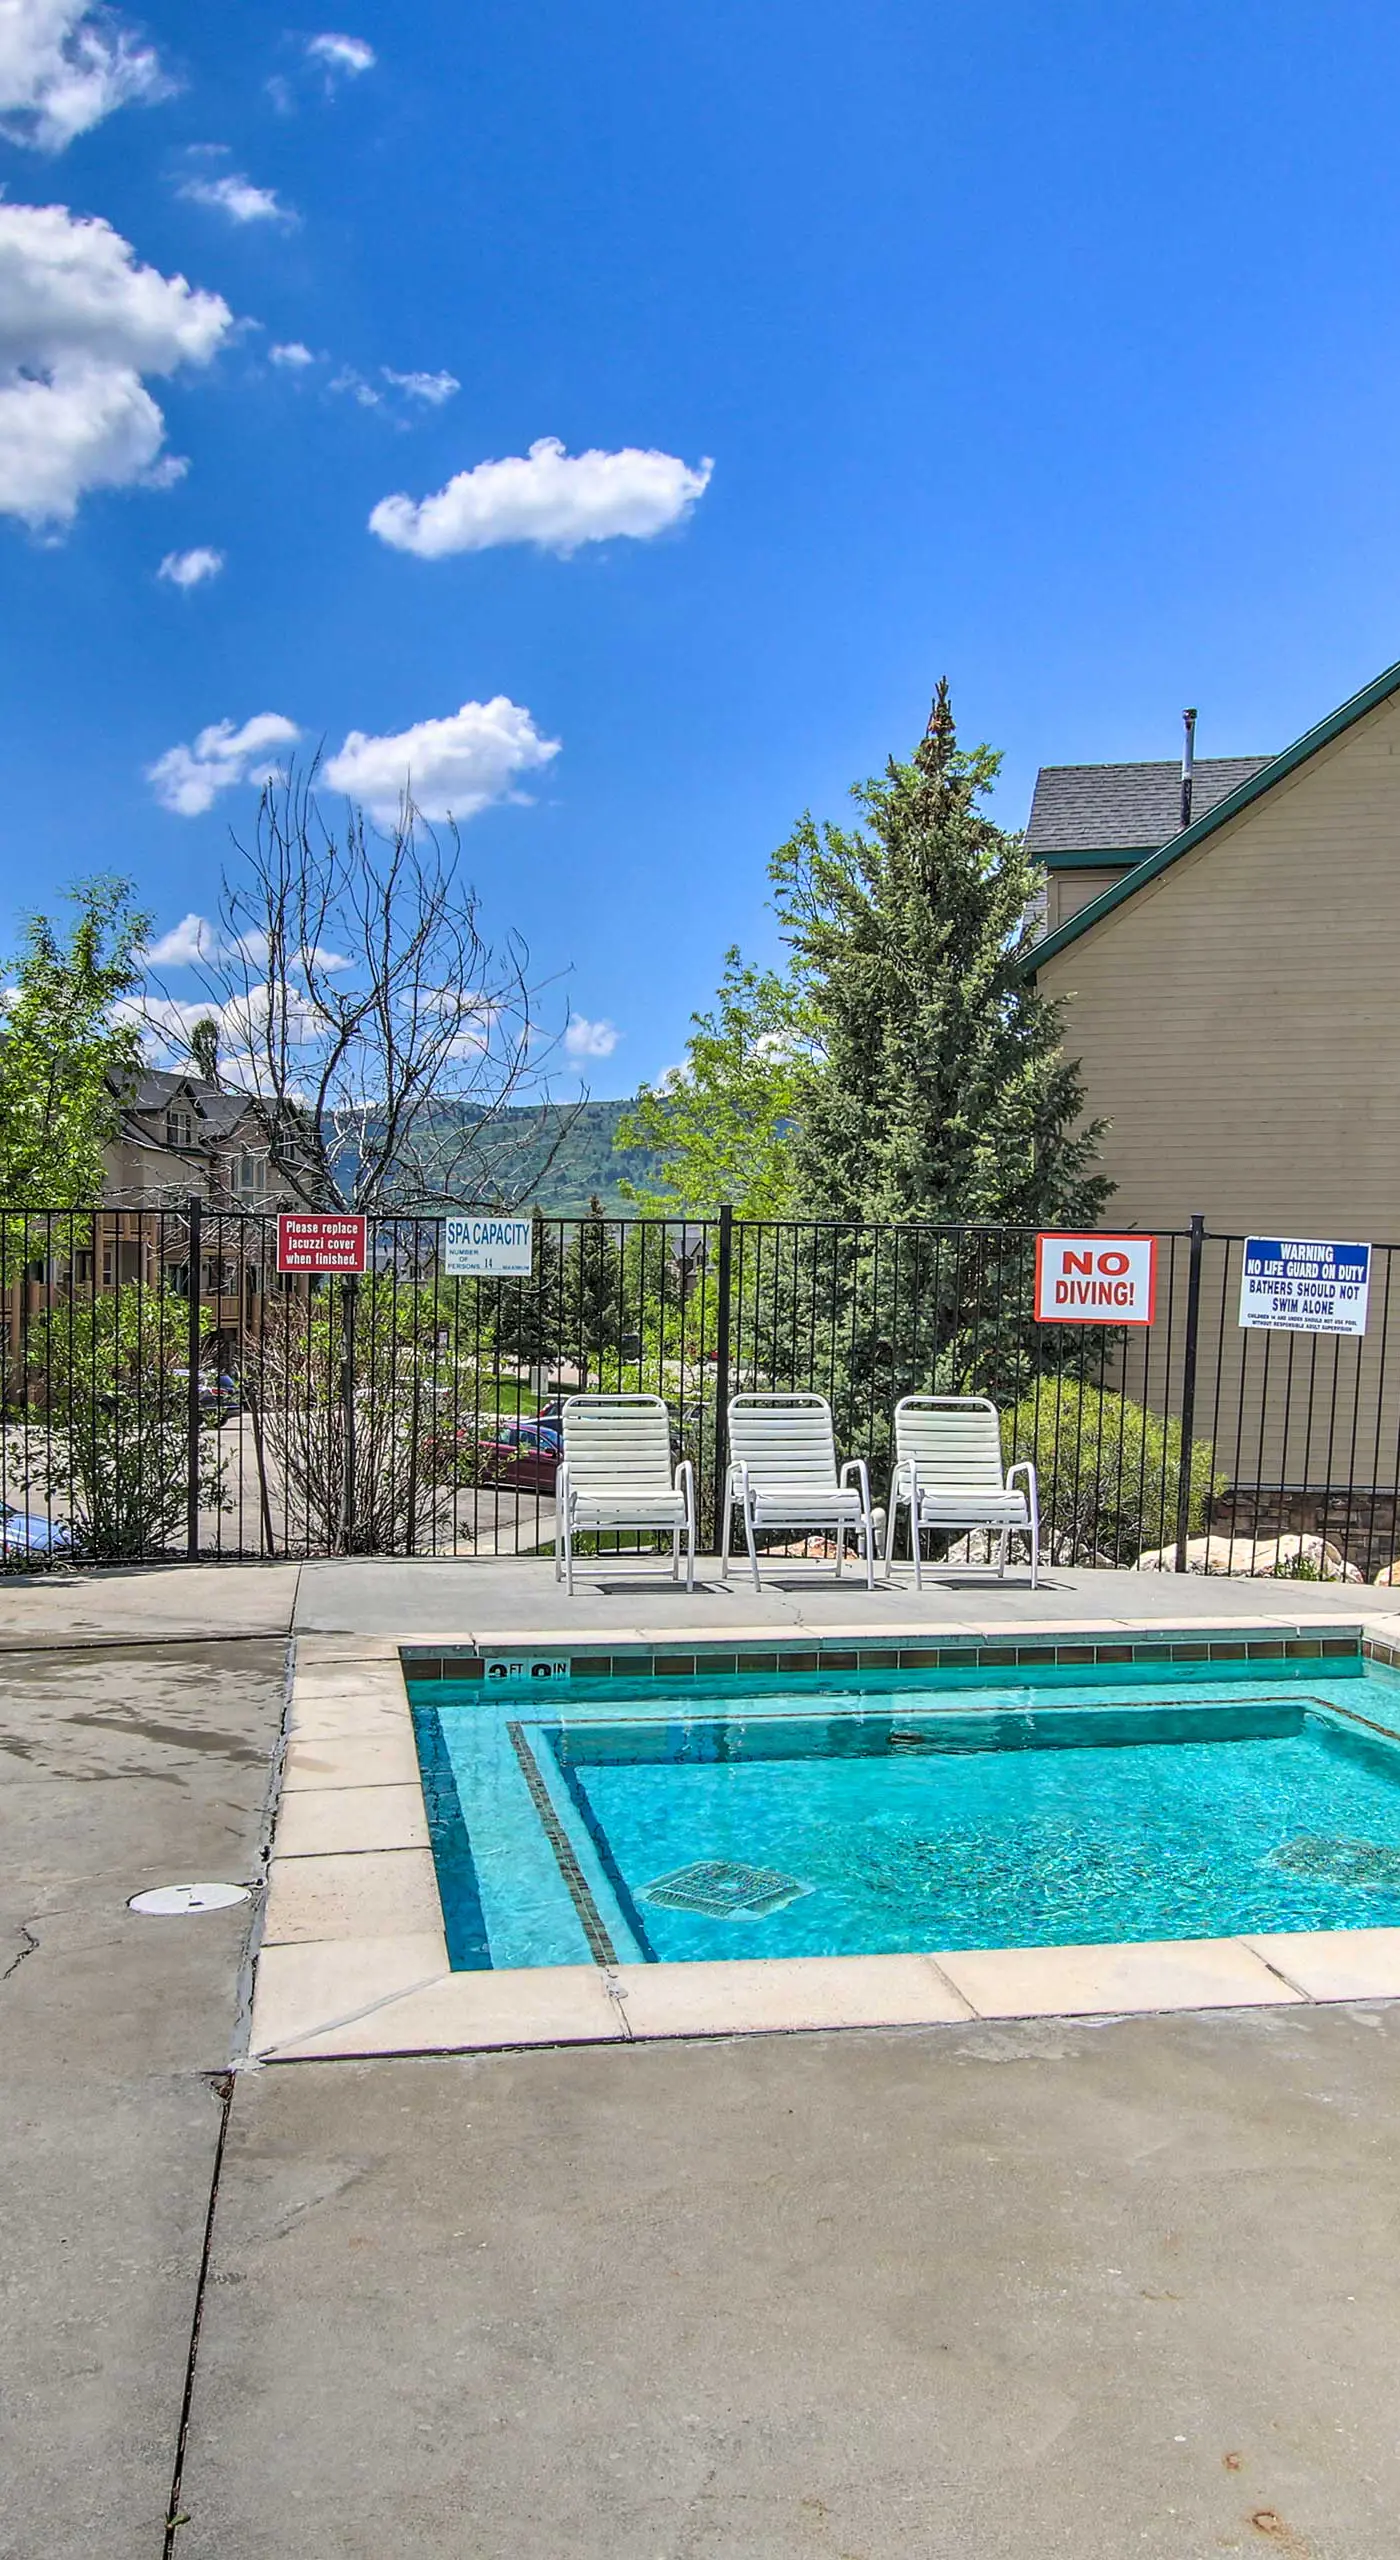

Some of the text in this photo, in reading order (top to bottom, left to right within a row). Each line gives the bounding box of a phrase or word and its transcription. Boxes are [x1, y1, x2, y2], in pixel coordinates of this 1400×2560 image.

[286, 1221, 358, 1236] Please replace
[448, 1223, 530, 1246] SPA CAPACITY
[288, 1237, 355, 1250] jacuzzi cover
[1281, 1243, 1334, 1263] WARNING
[286, 1252, 358, 1265] when finished.
[1063, 1251, 1130, 1276] NO
[1247, 1259, 1364, 1282] NO LIFE GUARD ON DUTY
[1055, 1280, 1135, 1306] DIVING!
[1249, 1280, 1360, 1300] BATHERS SHOULD NOT
[1272, 1298, 1334, 1315] SWIM ALONE
[510, 1664, 523, 1673] FT
[554, 1663, 566, 1673] IN
